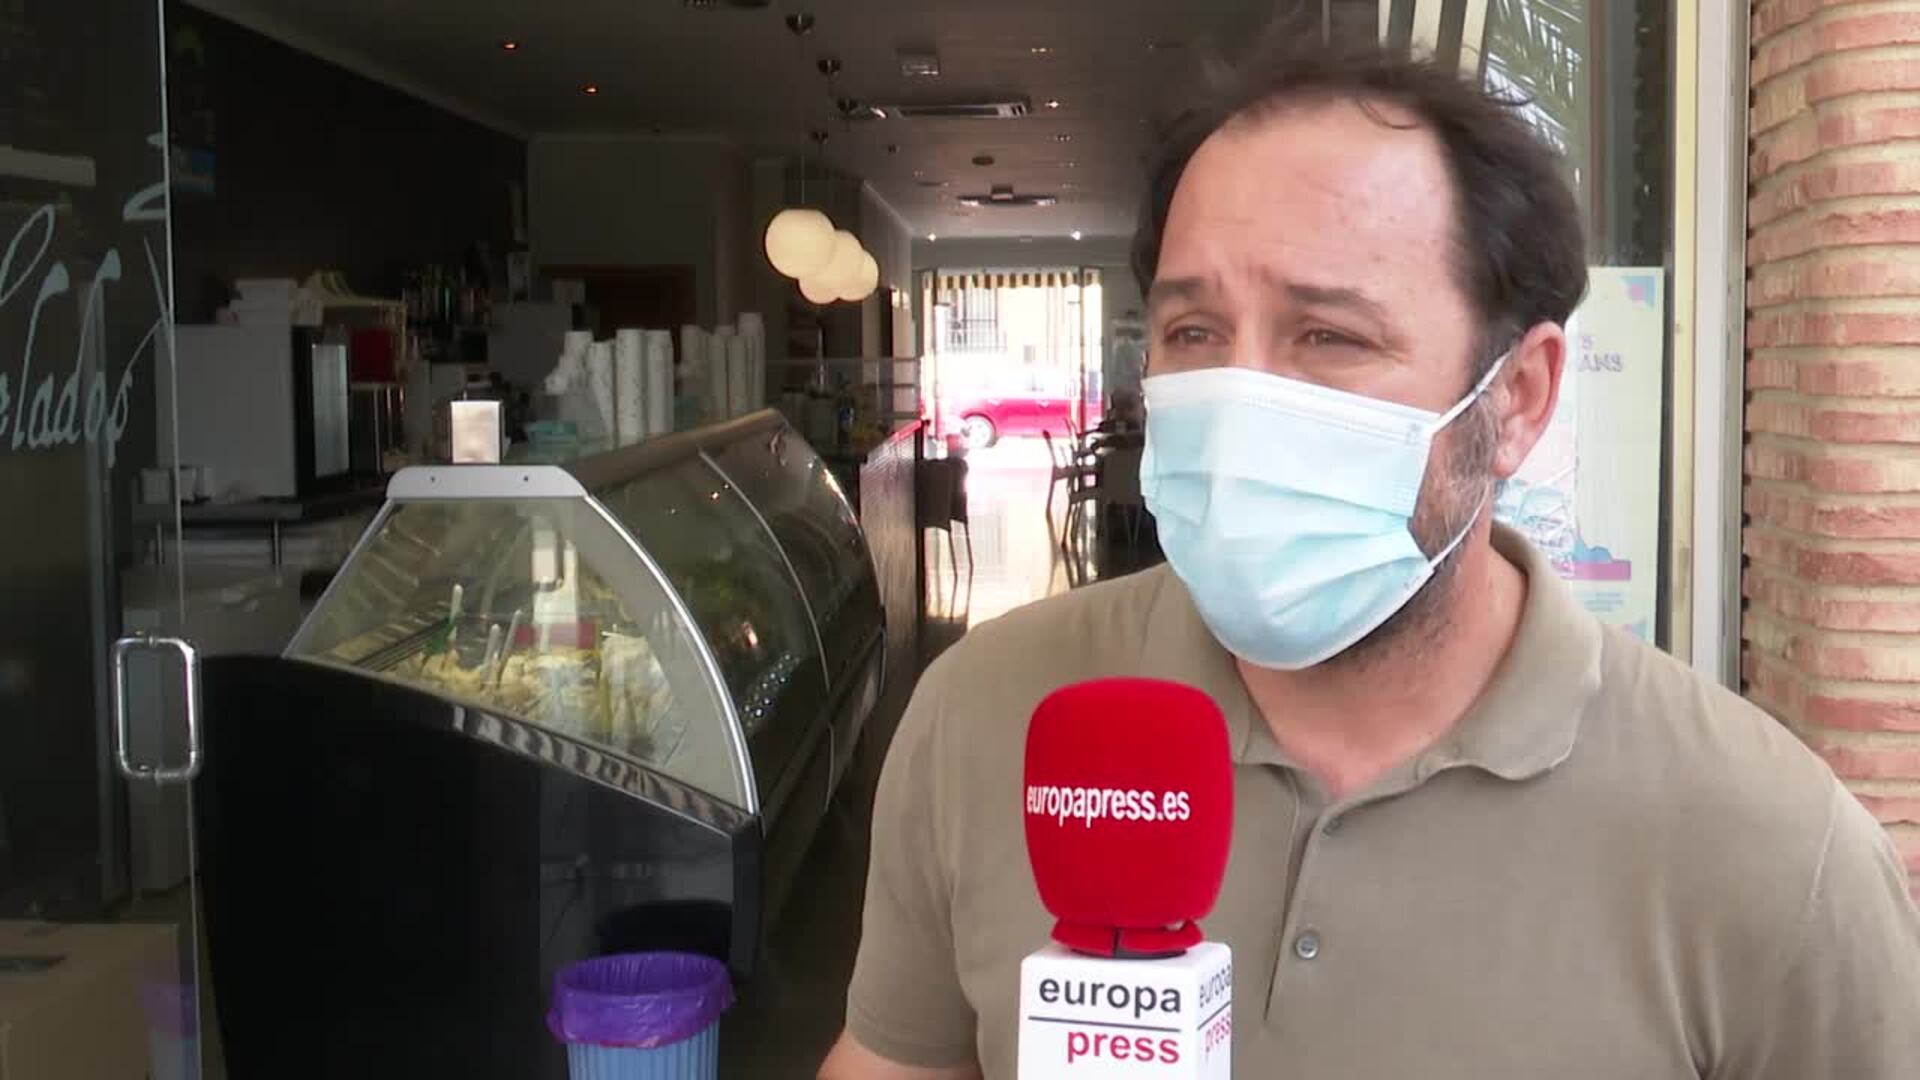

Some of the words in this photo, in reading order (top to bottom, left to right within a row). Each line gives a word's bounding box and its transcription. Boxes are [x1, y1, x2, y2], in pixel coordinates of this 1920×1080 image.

[1027, 785, 1191, 829] europapress.es
[1039, 977, 1181, 1019] europa
[1067, 1030, 1180, 1064] press
